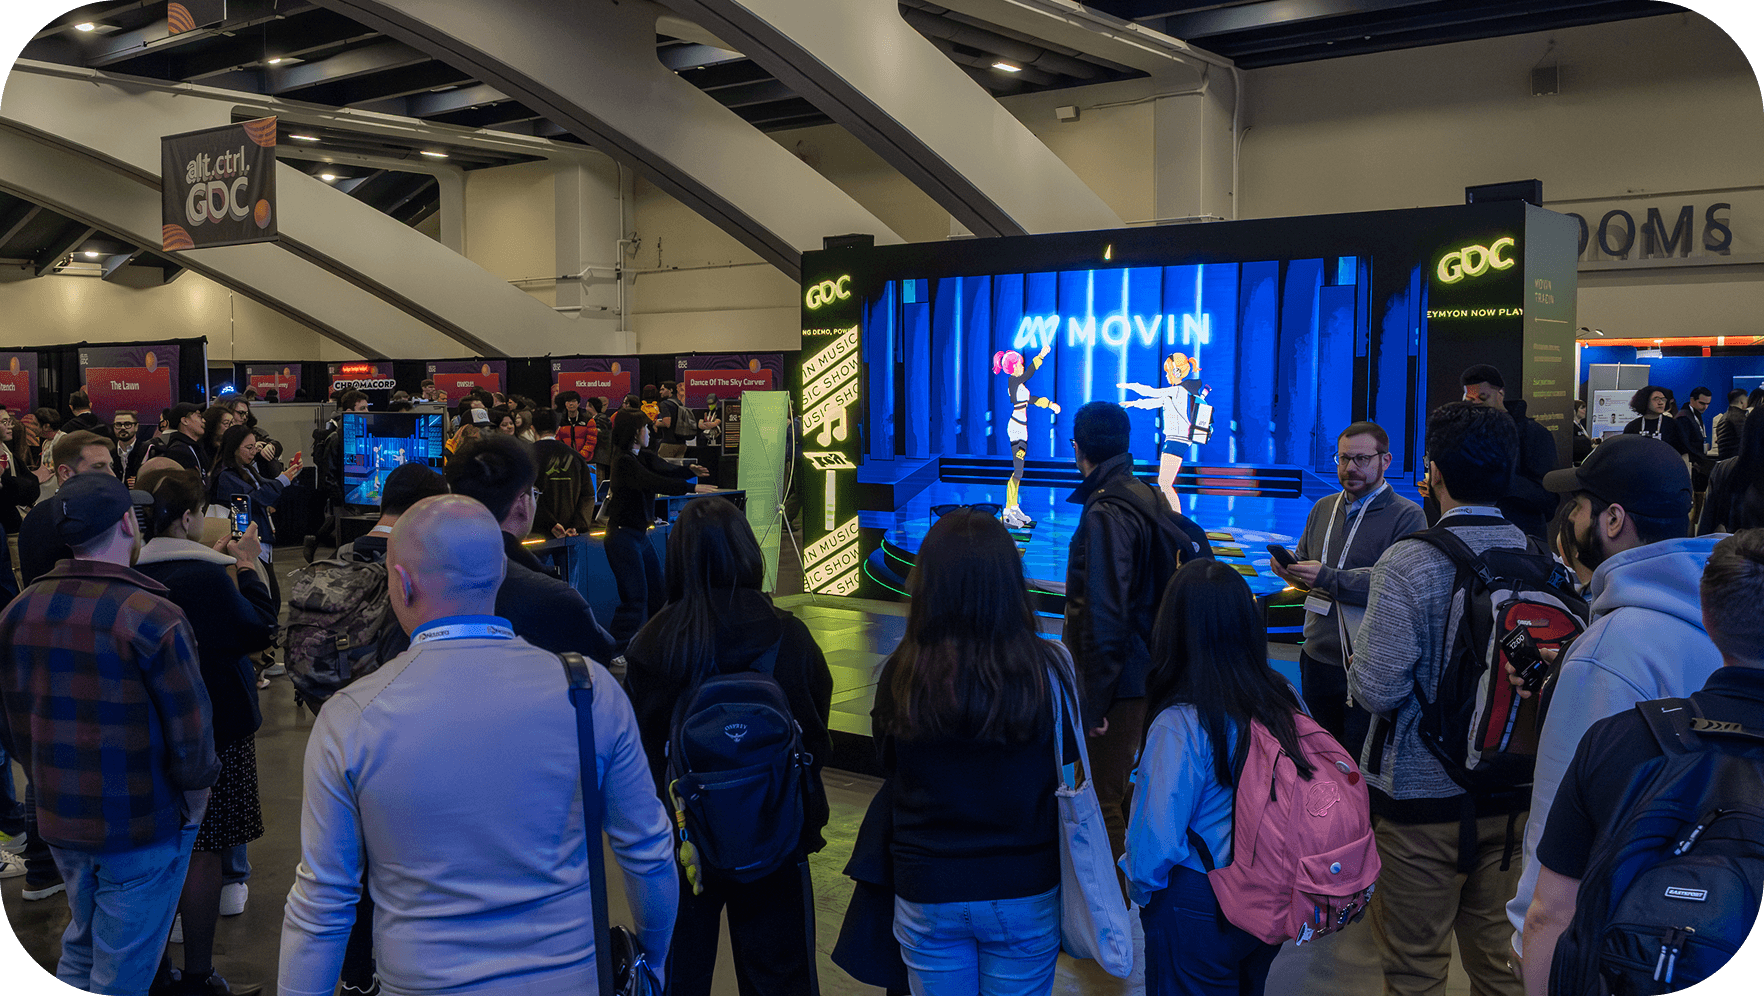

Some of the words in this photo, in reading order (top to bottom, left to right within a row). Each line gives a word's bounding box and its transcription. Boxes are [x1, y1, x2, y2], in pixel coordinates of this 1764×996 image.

[186, 145, 250, 183] alt.ctrl.
[186, 176, 250, 225] GDC
[1437, 237, 1515, 284] GDC
[806, 274, 851, 310] GDC
[1471, 309, 1496, 317] NOW
[812, 328, 832, 336] DEMO,
[1068, 313, 1210, 347] MOVIN
[818, 333, 858, 367] MUSIC
[110, 380, 121, 391] The
[122, 381, 140, 391] Lawn
[575, 380, 587, 388] Kick
[587, 380, 597, 388] and
[598, 380, 611, 388] Loud
[690, 378, 708, 386] Dance
[709, 378, 717, 386] Of
[718, 378, 729, 386] The
[730, 378, 742, 387] Sky
[743, 378, 765, 386] Carver
[819, 523, 859, 553] MUSIC
